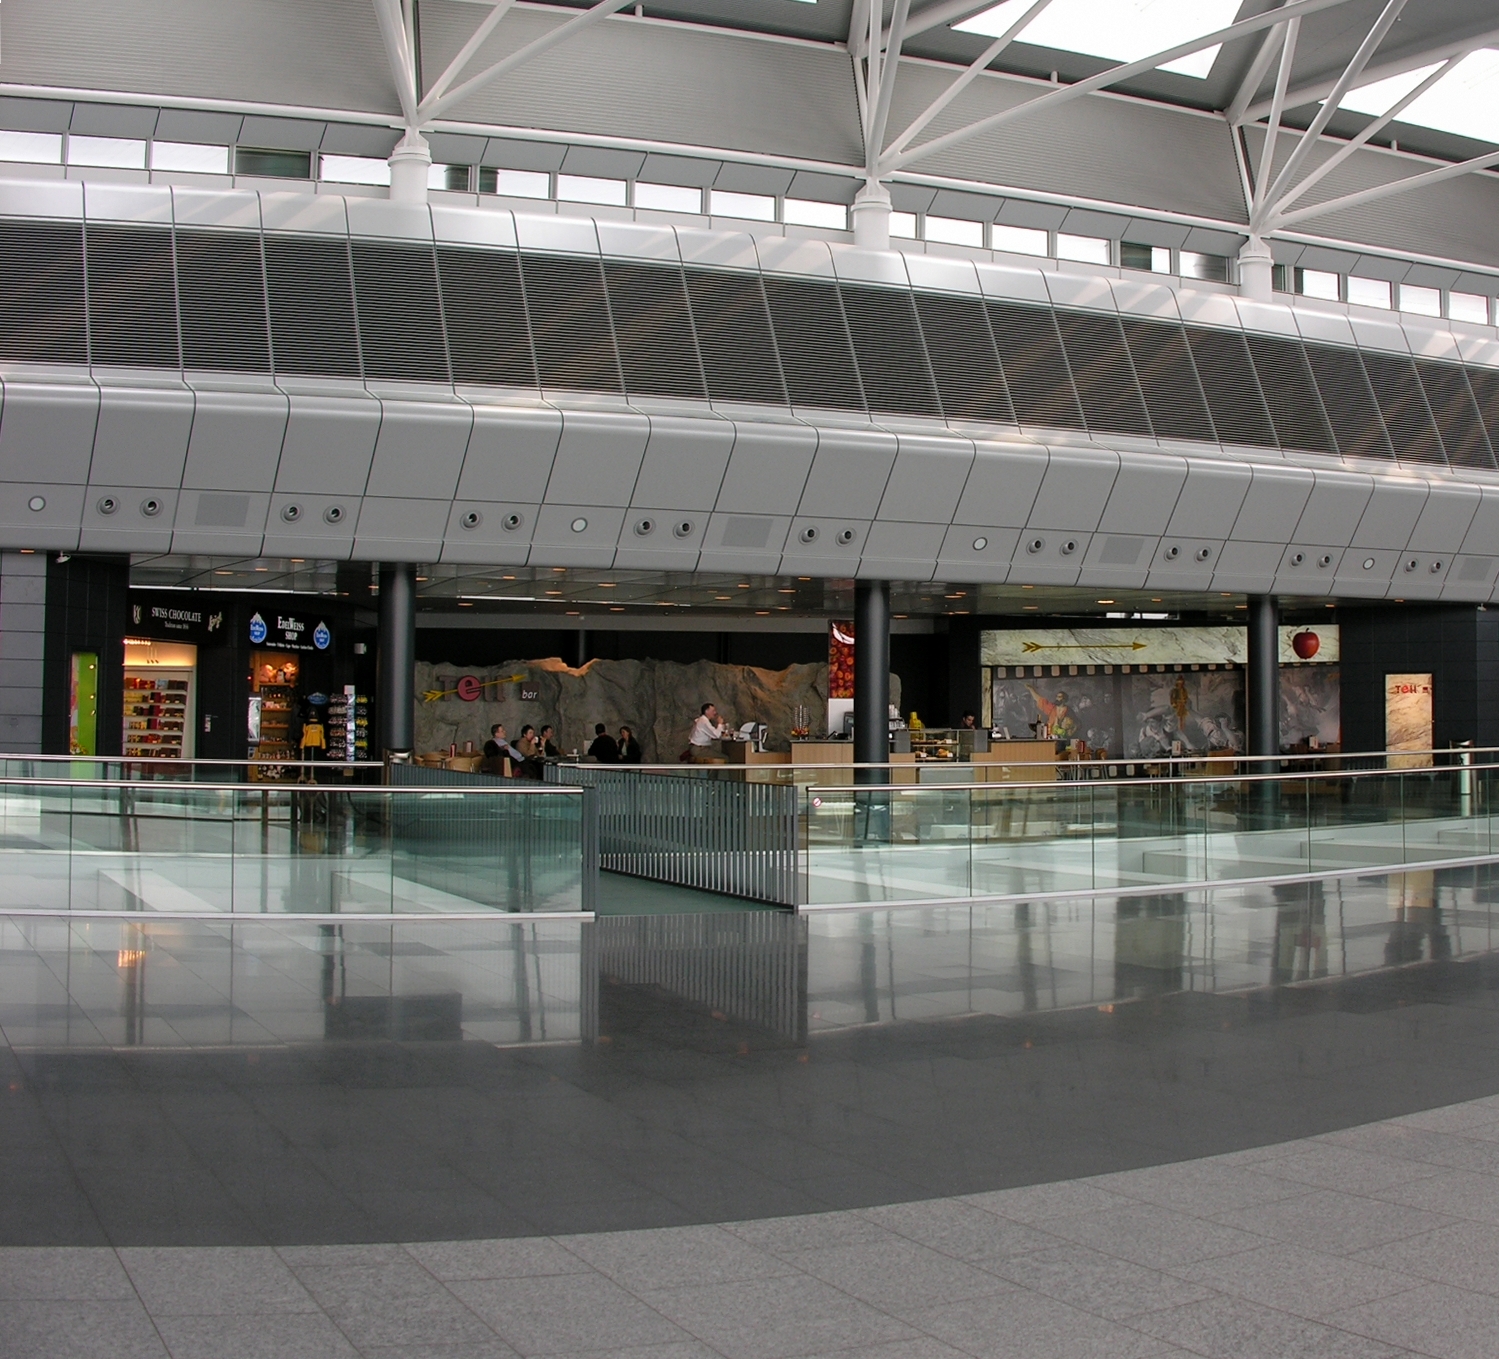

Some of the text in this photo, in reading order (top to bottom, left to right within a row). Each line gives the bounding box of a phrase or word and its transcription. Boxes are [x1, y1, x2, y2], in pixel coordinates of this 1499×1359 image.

[151, 606, 167, 618] SWISS
[168, 608, 201, 622] CHOCOLATE
[521, 689, 537, 699] bar
